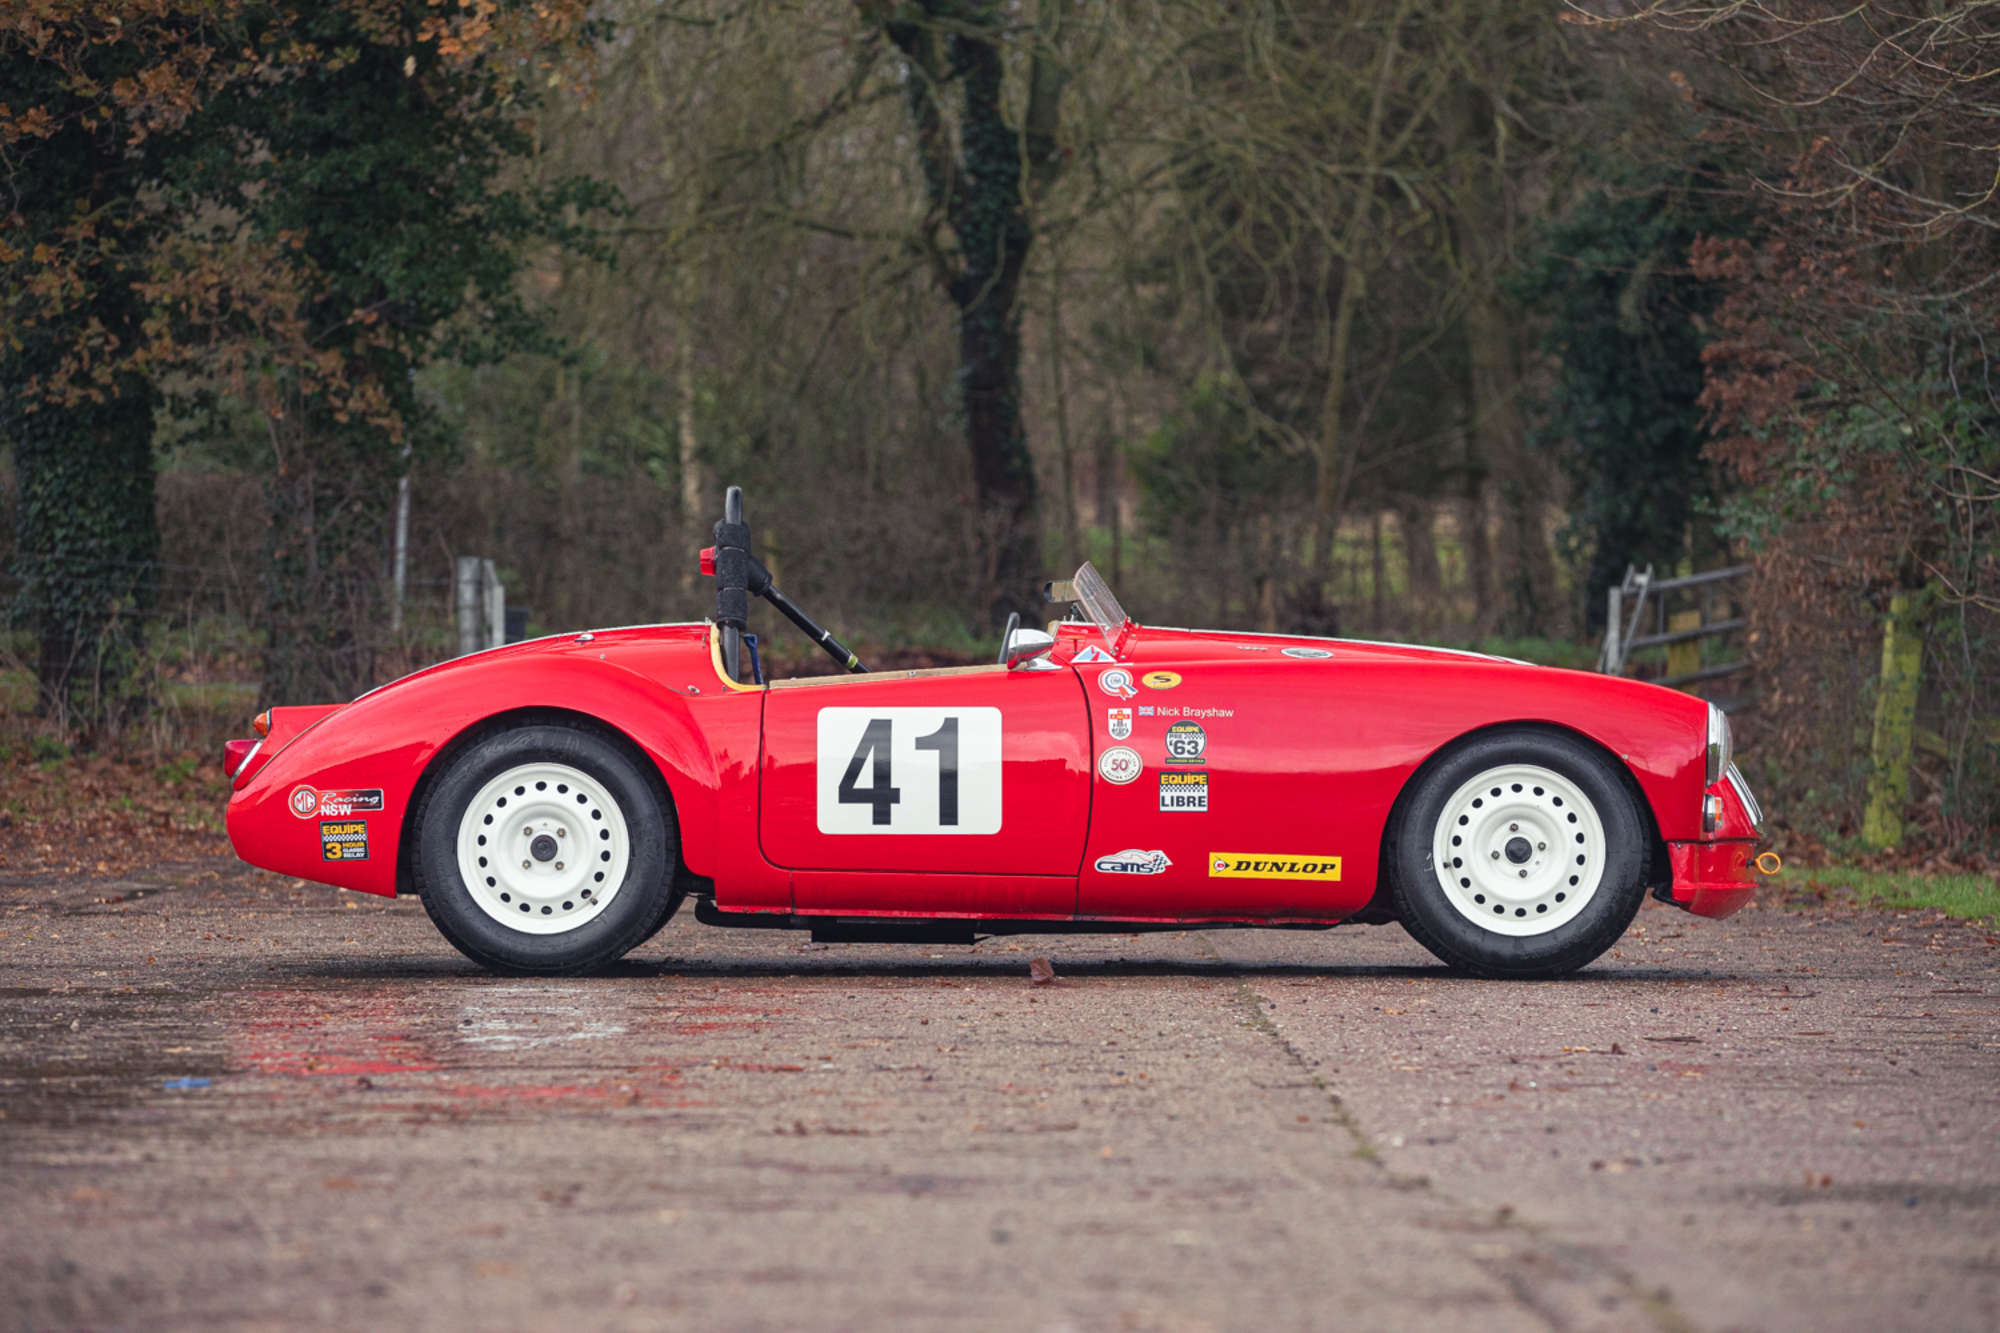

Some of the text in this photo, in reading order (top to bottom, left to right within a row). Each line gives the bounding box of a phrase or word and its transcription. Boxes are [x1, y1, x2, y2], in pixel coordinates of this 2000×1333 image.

[1157, 707, 1234, 719] Nick Brayshaw
[838, 717, 958, 826] 41
[1160, 773, 1207, 785] EQUIPE
[294, 790, 316, 812] MG
[321, 792, 379, 806] Racing
[1161, 795, 1207, 807] LIBRE
[320, 804, 352, 816] NSW
[322, 824, 365, 835] EQUIPE
[325, 842, 342, 859] 3
[1233, 860, 1336, 874] DUNLOP
